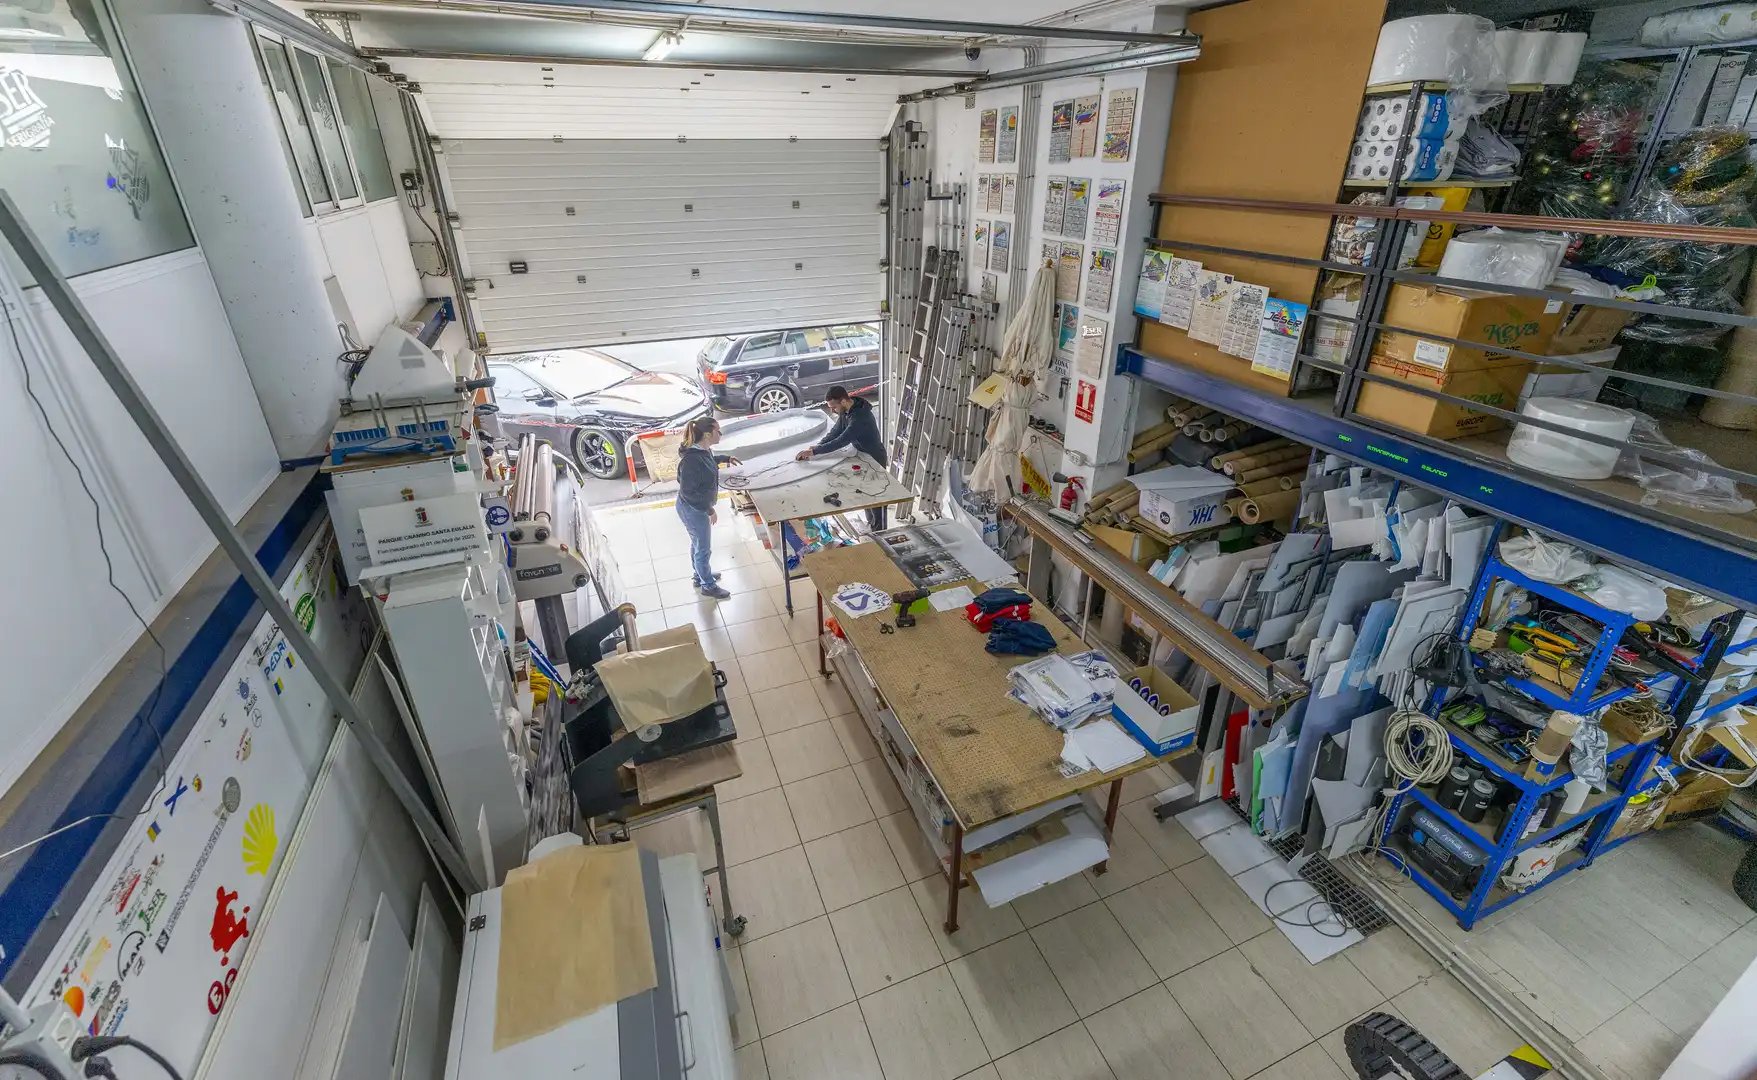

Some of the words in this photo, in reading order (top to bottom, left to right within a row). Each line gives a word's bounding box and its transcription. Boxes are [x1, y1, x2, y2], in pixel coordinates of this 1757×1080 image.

[1480, 485, 1494, 494] PVC
[1188, 504, 1217, 526] JHK
[378, 536, 403, 545] PARQUE
[431, 528, 450, 536] SANTA
[122, 937, 145, 978] MAN
